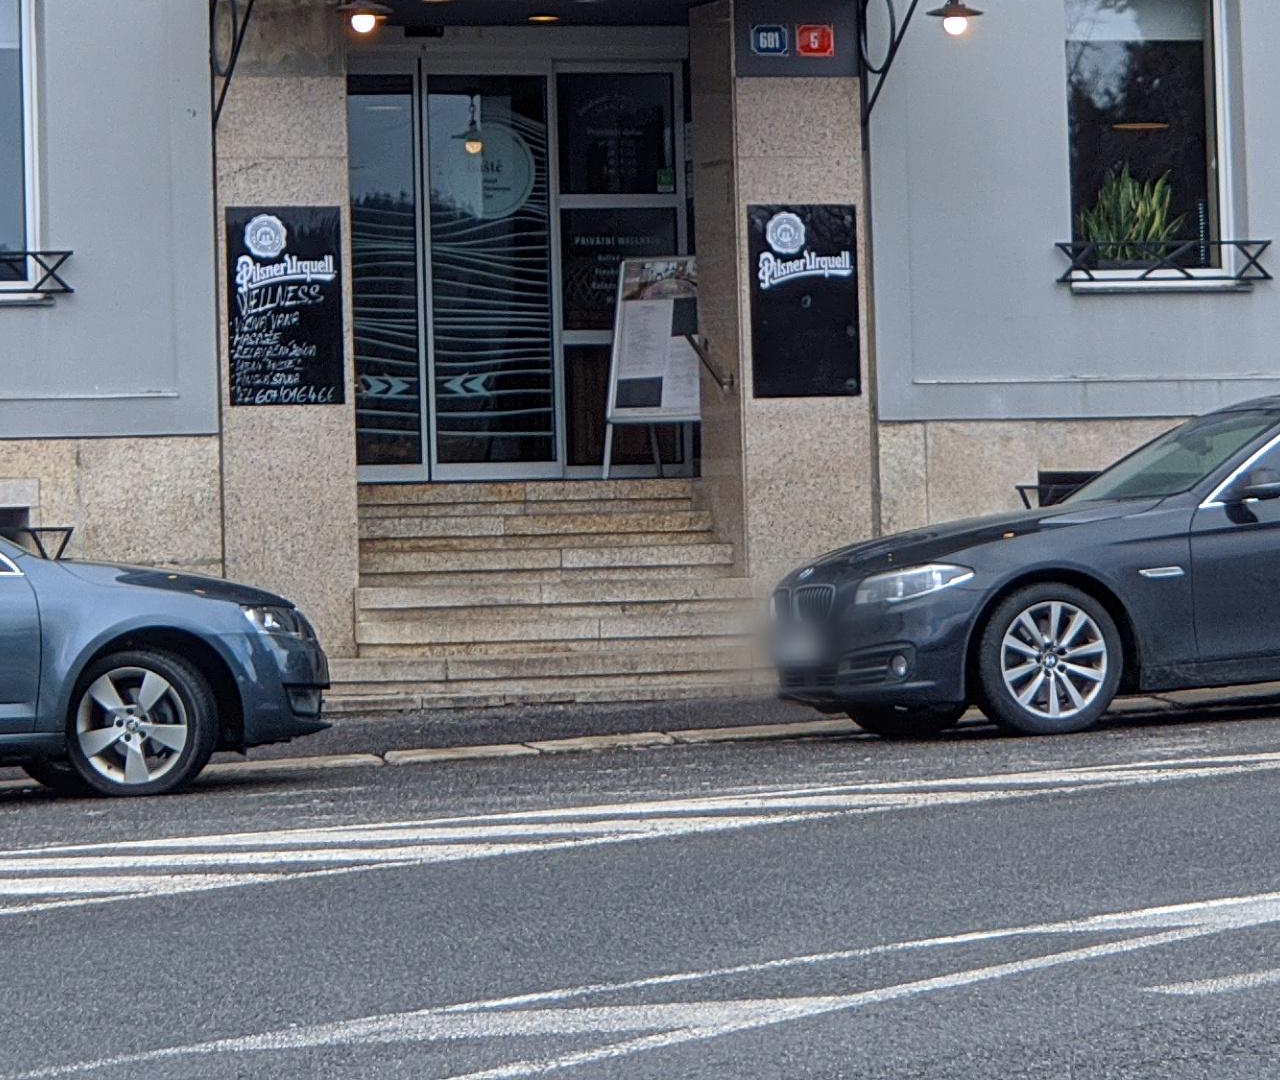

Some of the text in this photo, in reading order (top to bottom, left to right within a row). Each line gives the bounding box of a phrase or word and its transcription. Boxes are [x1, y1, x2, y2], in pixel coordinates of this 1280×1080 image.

[809, 32, 819, 49] 5
[235, 253, 336, 293] Pilsner Urquell
[758, 249, 850, 290] Pilsner Urquell
